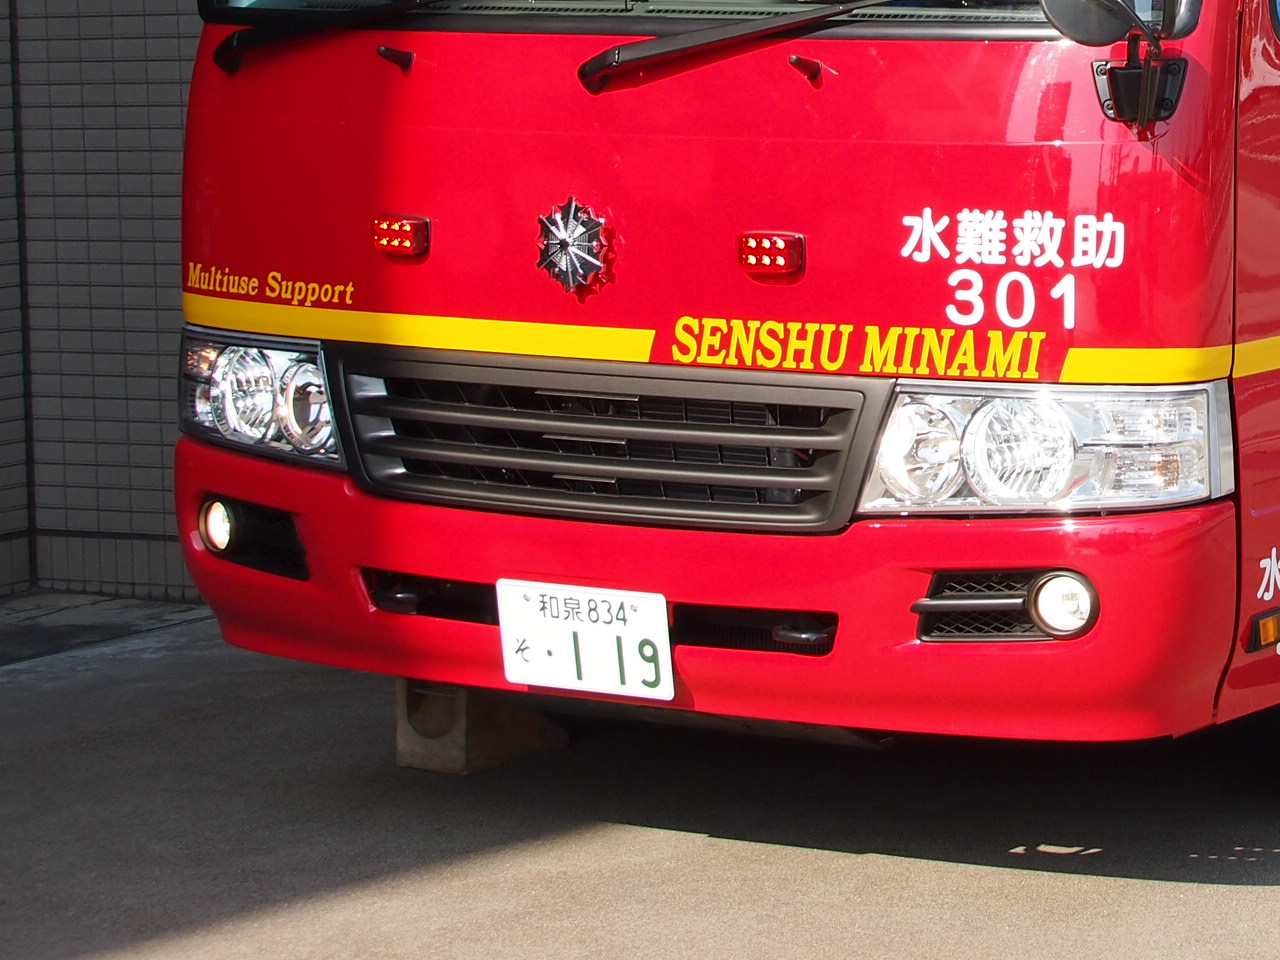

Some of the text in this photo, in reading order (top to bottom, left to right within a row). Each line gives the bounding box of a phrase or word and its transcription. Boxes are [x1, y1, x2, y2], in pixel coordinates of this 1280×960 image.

[900, 207, 1125, 269] 水難救助
[187, 262, 354, 306] Multiuse Support
[945, 268, 1076, 330] 301
[671, 315, 1047, 379] SENSHU MINAMI
